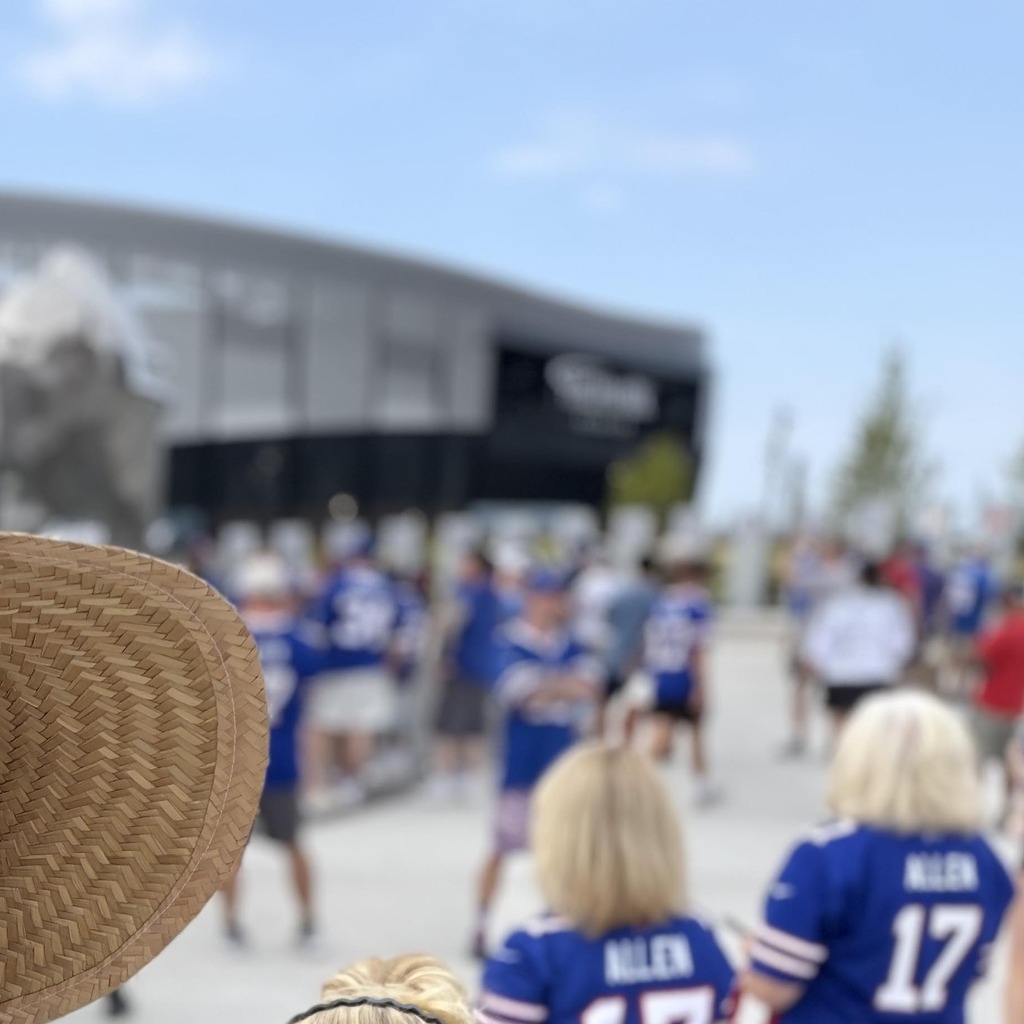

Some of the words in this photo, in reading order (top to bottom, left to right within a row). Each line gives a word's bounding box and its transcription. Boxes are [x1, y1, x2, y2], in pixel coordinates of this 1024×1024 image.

[903, 850, 981, 894] ALLEN
[603, 932, 696, 986] ALLEN
[873, 902, 985, 1014] 17
